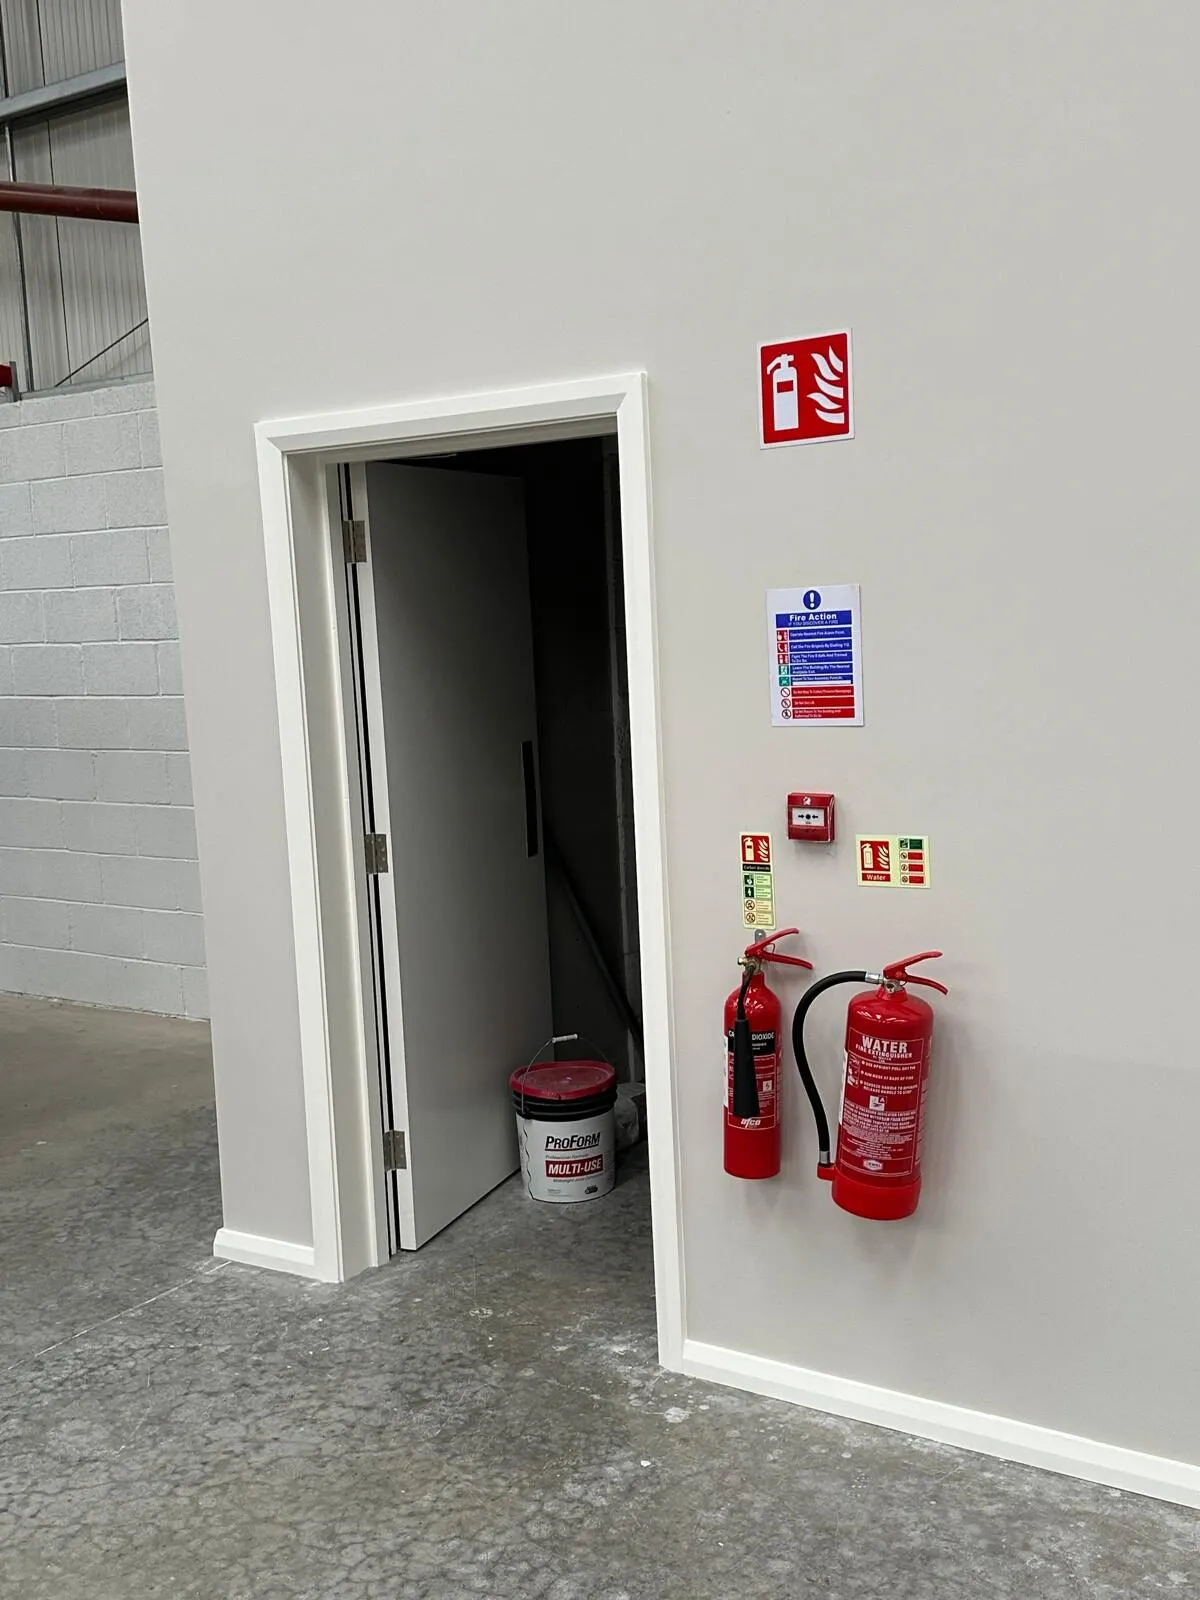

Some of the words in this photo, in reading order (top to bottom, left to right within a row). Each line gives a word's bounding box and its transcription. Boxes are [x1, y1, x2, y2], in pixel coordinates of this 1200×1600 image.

[808, 613, 837, 621] Action
[855, 1043, 867, 1053] FIRE
[868, 1050, 913, 1059] EXTINGUISHER
[862, 1035, 908, 1053] WATER
[548, 1158, 602, 1175] MULTI-USE
